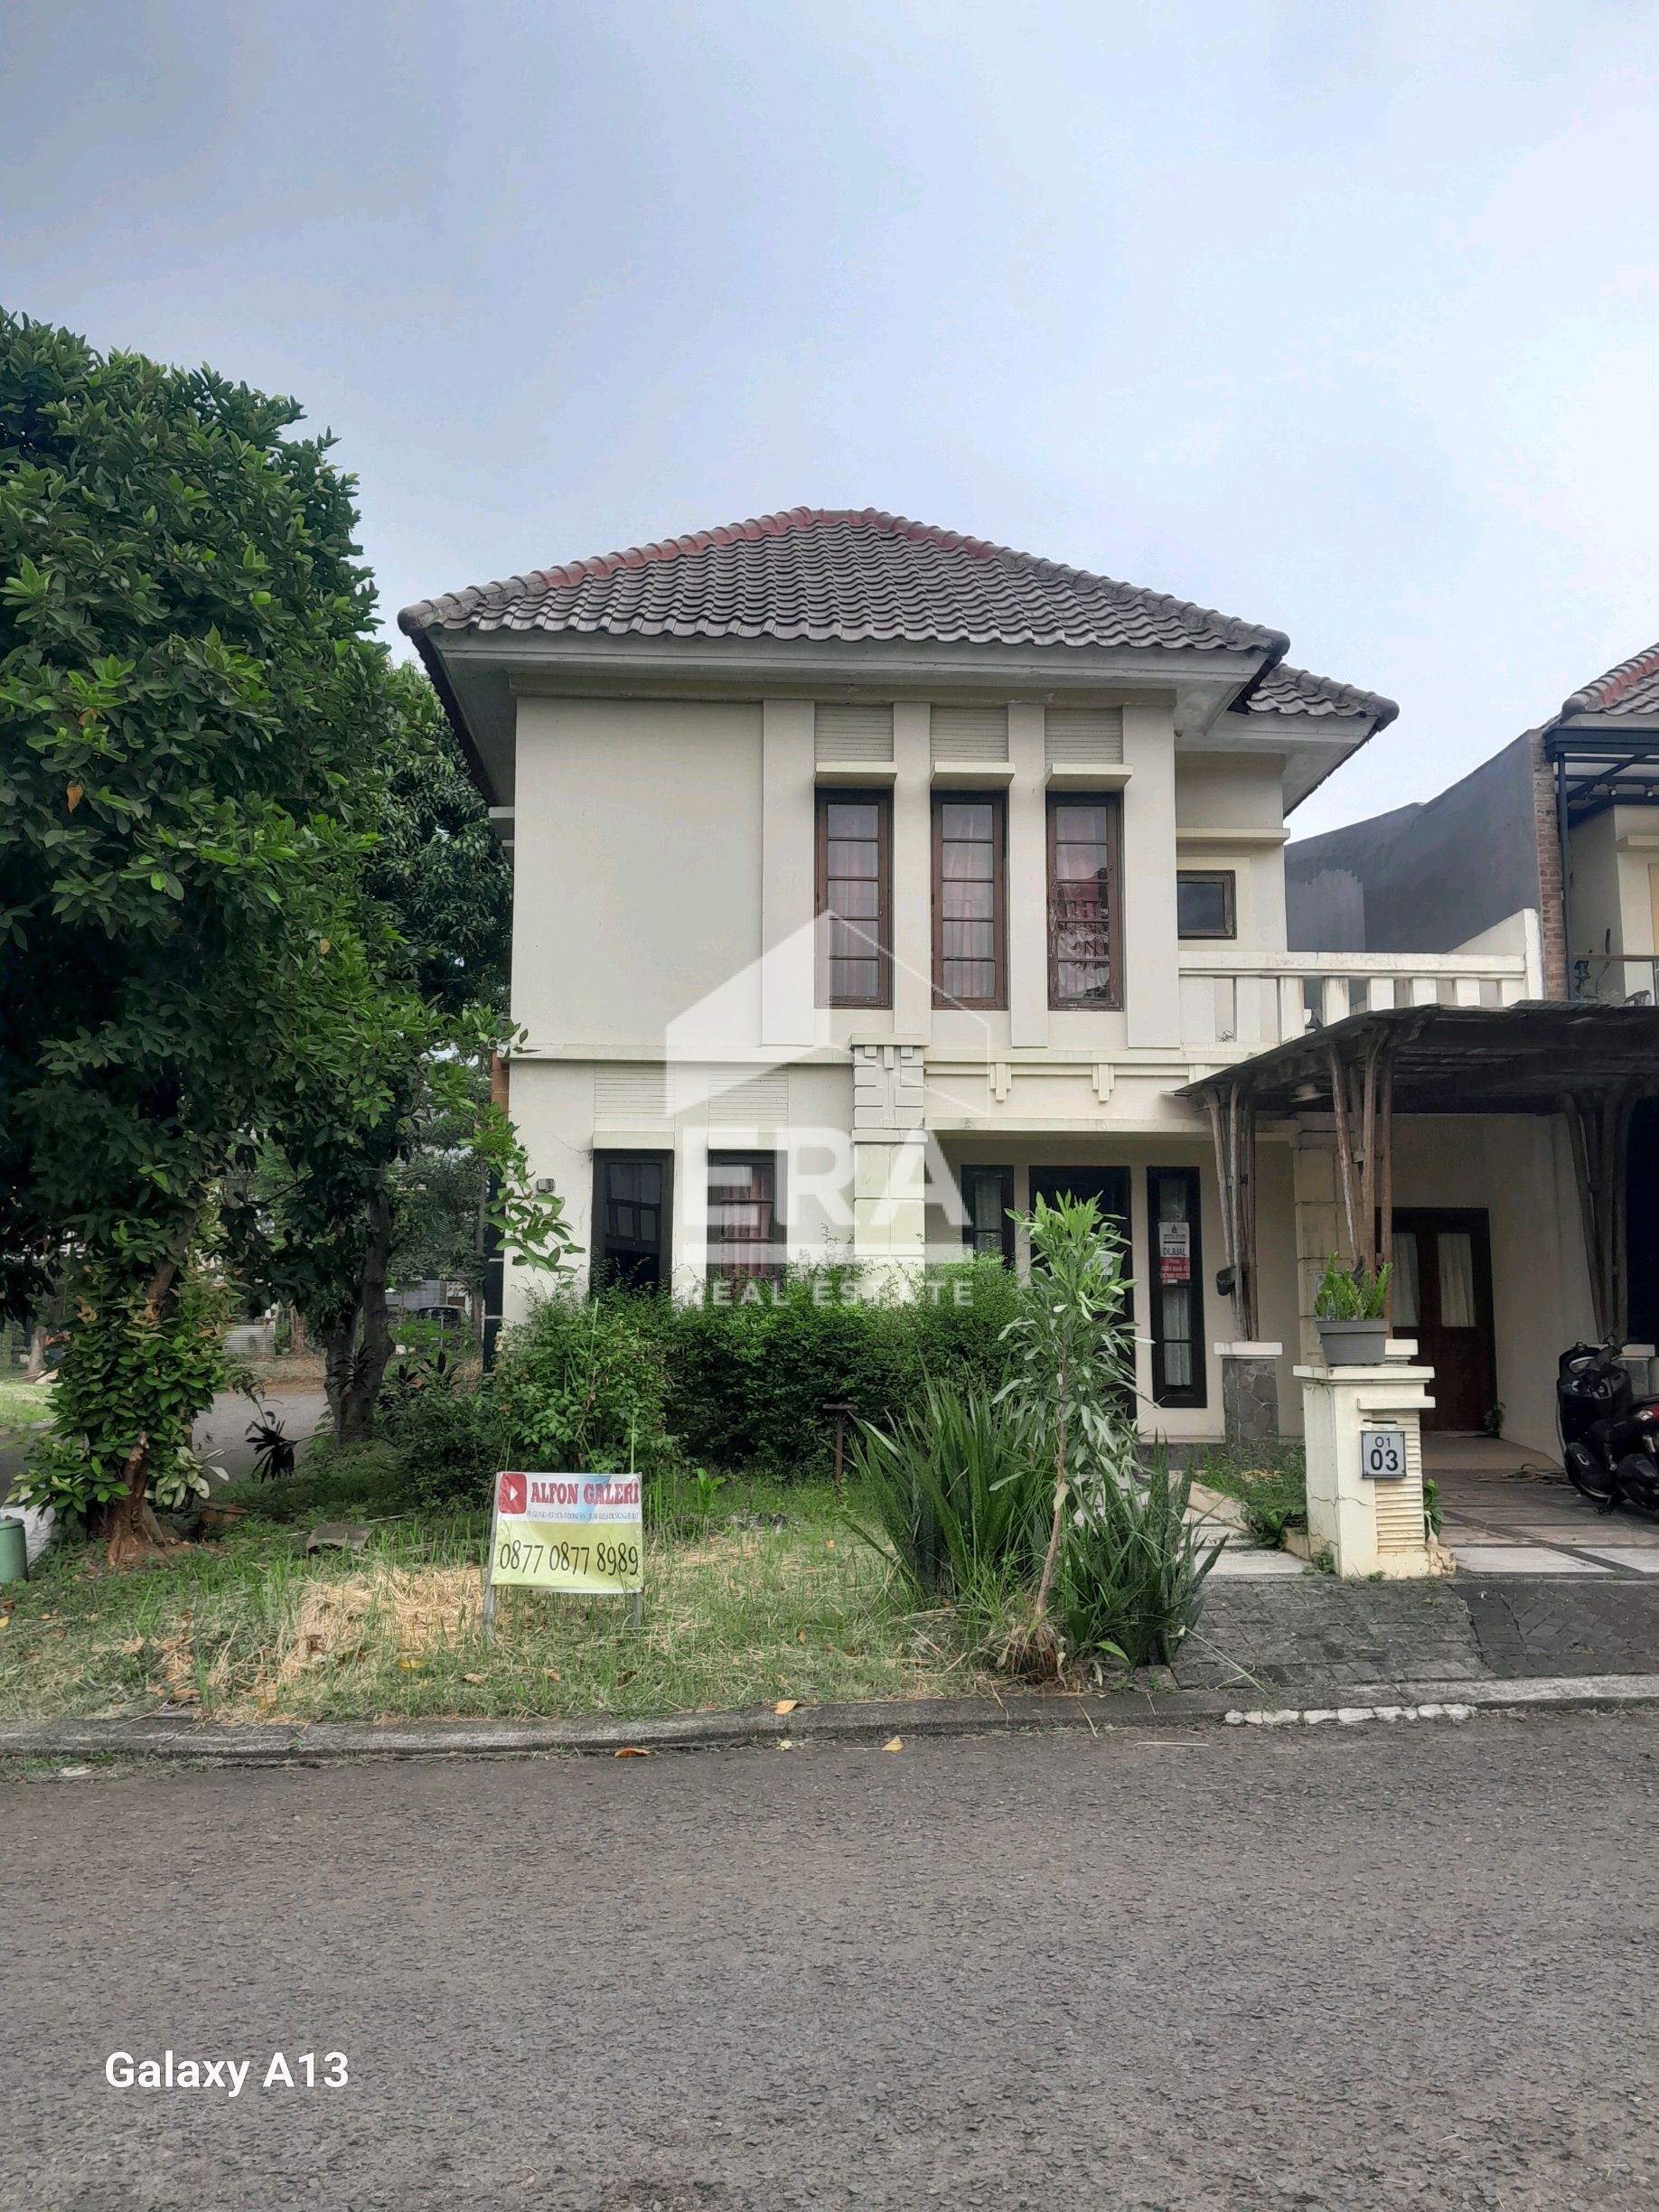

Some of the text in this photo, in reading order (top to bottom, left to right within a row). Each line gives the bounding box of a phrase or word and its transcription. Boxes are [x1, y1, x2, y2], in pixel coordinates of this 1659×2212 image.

[1163, 1247, 1186, 1256] DIJUAL
[1370, 1448, 1399, 1471] 03
[530, 1482, 640, 1504] ALFON GALERI
[500, 1540, 639, 1576] 0877 0877 8989
